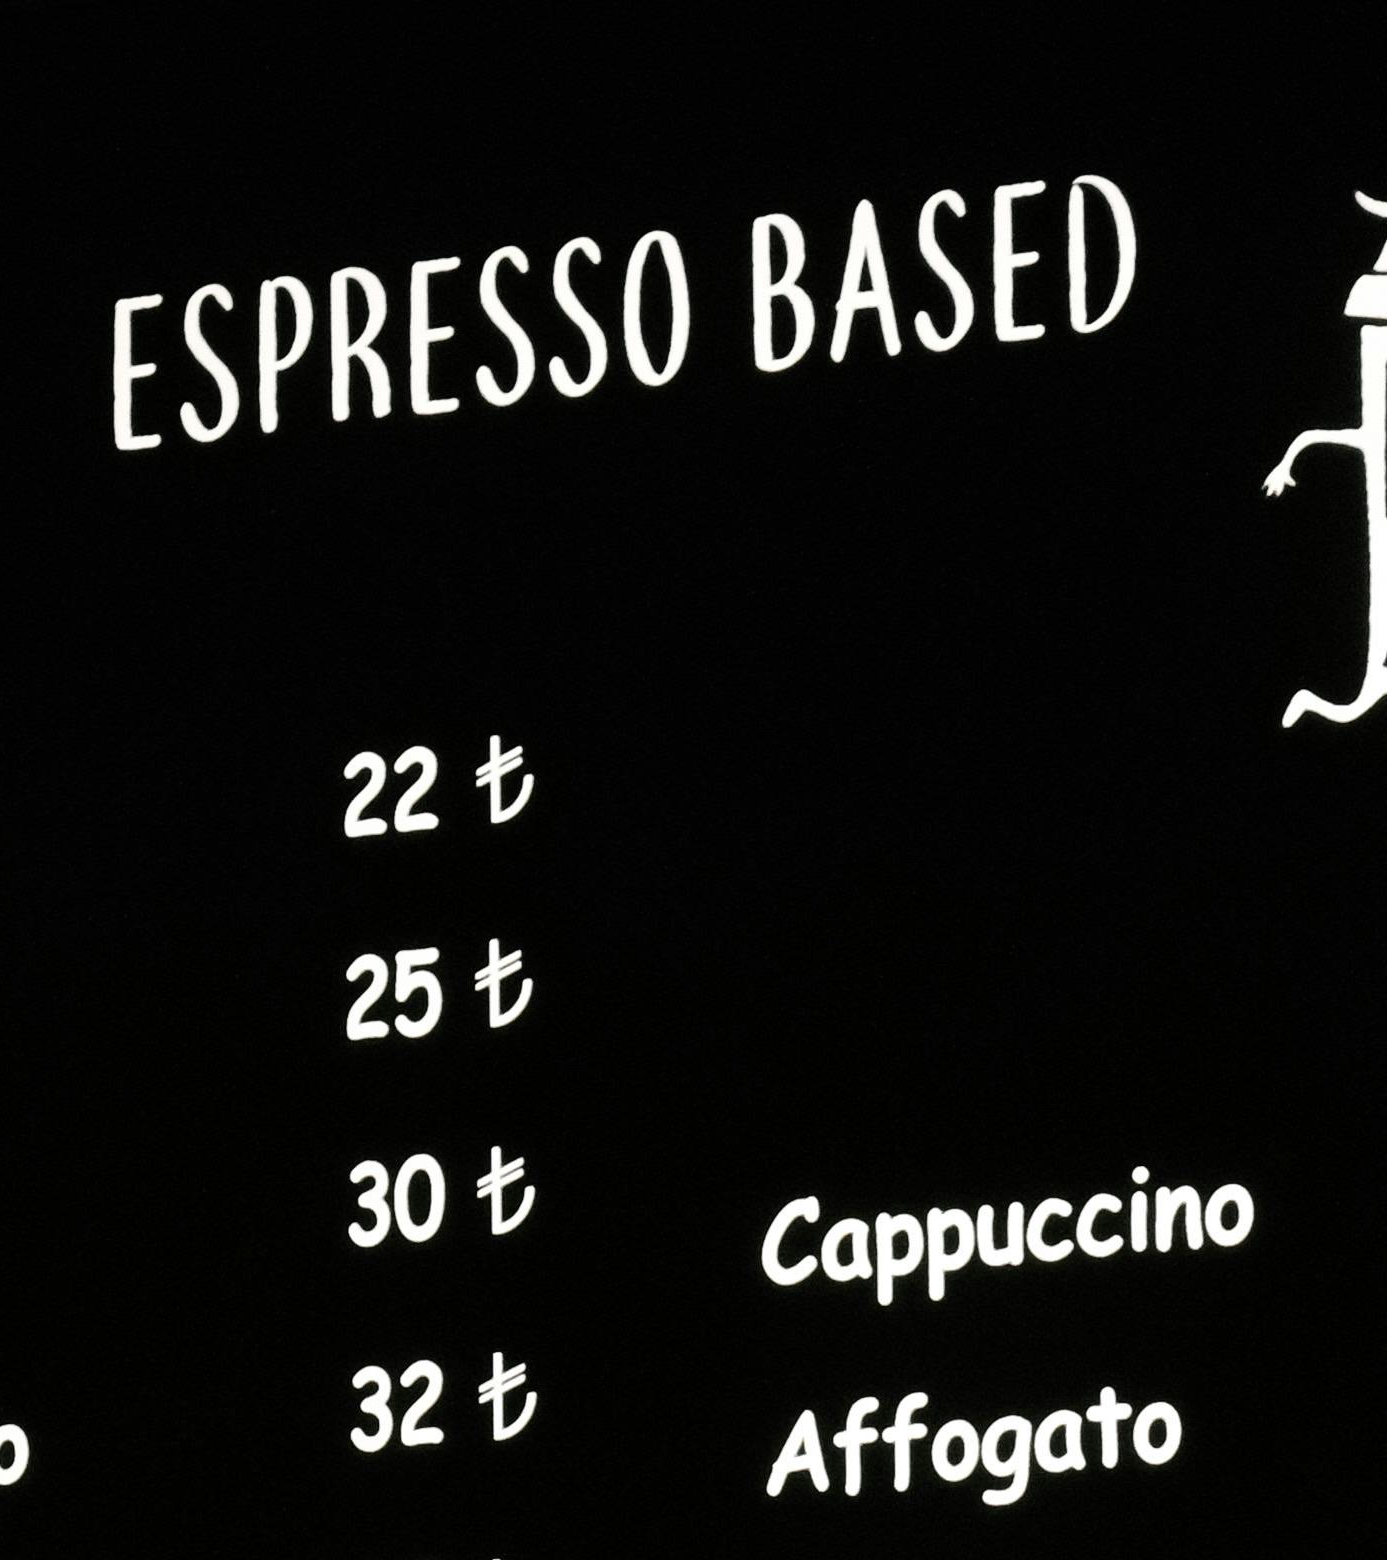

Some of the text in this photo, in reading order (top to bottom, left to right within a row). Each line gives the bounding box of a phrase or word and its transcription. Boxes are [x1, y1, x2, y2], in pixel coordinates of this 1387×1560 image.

[112, 173, 1138, 452] ESPRESSO BASED
[342, 744, 441, 839] 22
[344, 945, 445, 1042] 25
[346, 1152, 447, 1249] 30
[760, 1164, 1256, 1308] Cappuccino
[349, 1358, 446, 1454] 32
[764, 1385, 1184, 1508] Affogato
